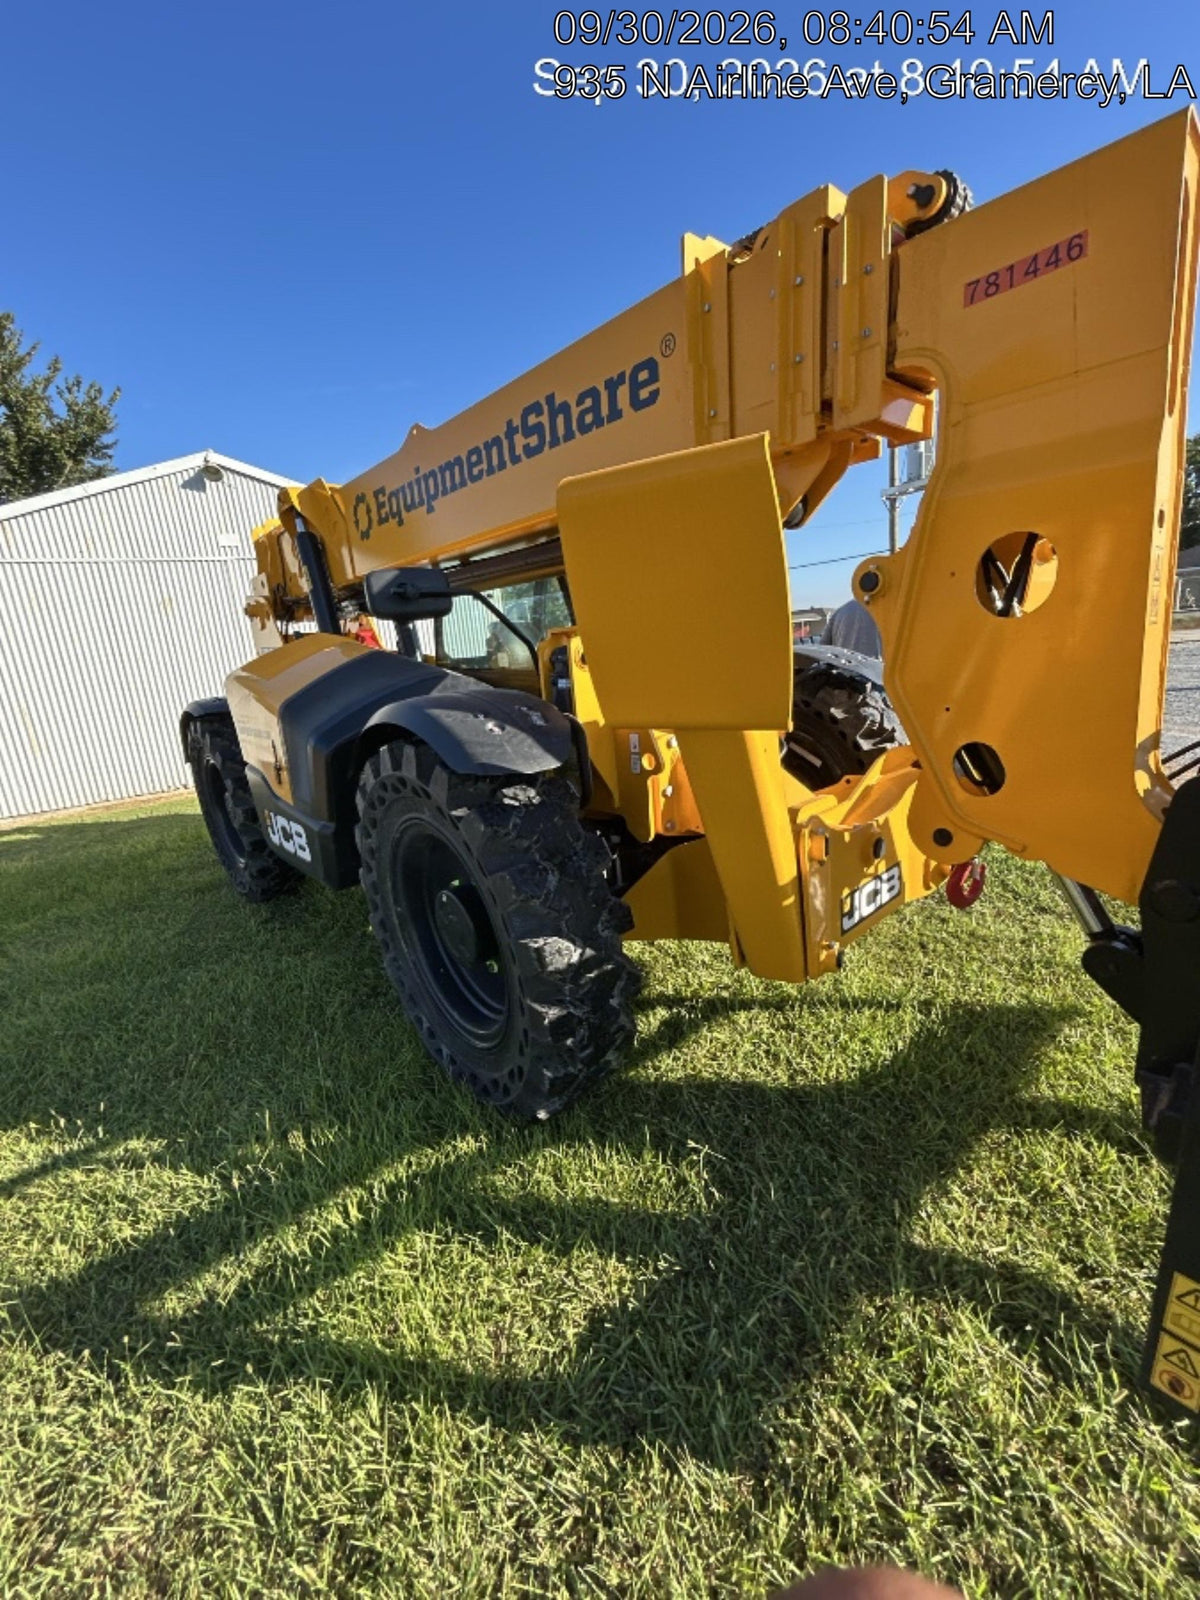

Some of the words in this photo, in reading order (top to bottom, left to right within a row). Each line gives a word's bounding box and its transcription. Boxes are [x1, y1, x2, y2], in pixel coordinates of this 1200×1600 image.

[966, 233, 1084, 305] 781446
[372, 356, 661, 527] EquipmentShare
[264, 809, 313, 863] JCB
[841, 864, 901, 932] JCB
